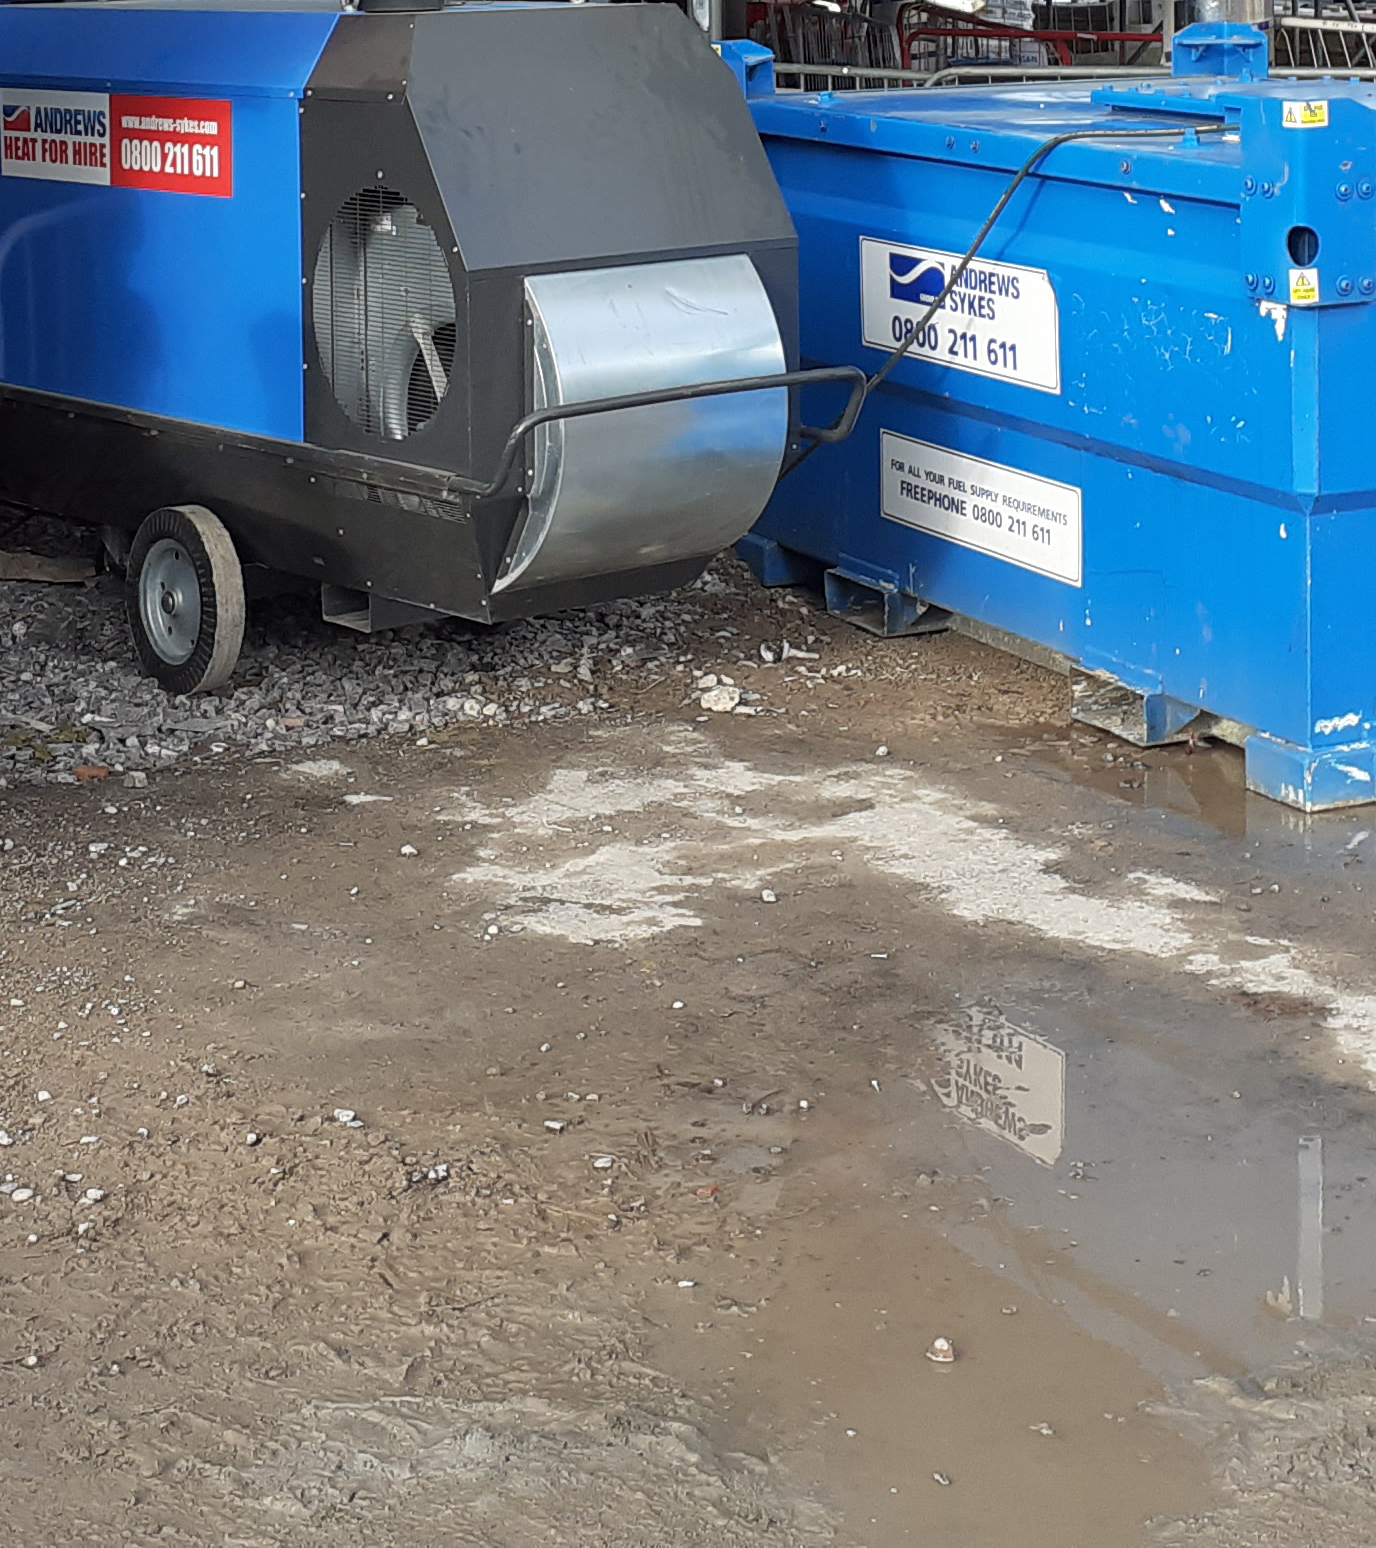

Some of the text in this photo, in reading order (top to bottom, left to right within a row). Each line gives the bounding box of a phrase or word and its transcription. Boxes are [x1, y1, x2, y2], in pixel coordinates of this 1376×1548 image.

[34, 106, 106, 138] ANDREWS
[121, 115, 218, 135] www.andrews-sykes.com
[3, 135, 107, 168] HEAT FOR HIRE
[121, 138, 219, 177] 0800 211 611
[950, 265, 1021, 300] ANDREWS
[949, 290, 996, 321] SYKES
[891, 315, 1018, 371] 0800 211 611
[890, 458, 1068, 526] FOR ALL YOUR FUEL SUPPLY REQUIREMENTS
[900, 480, 1051, 546] FREEPHONE 0800 211 611
